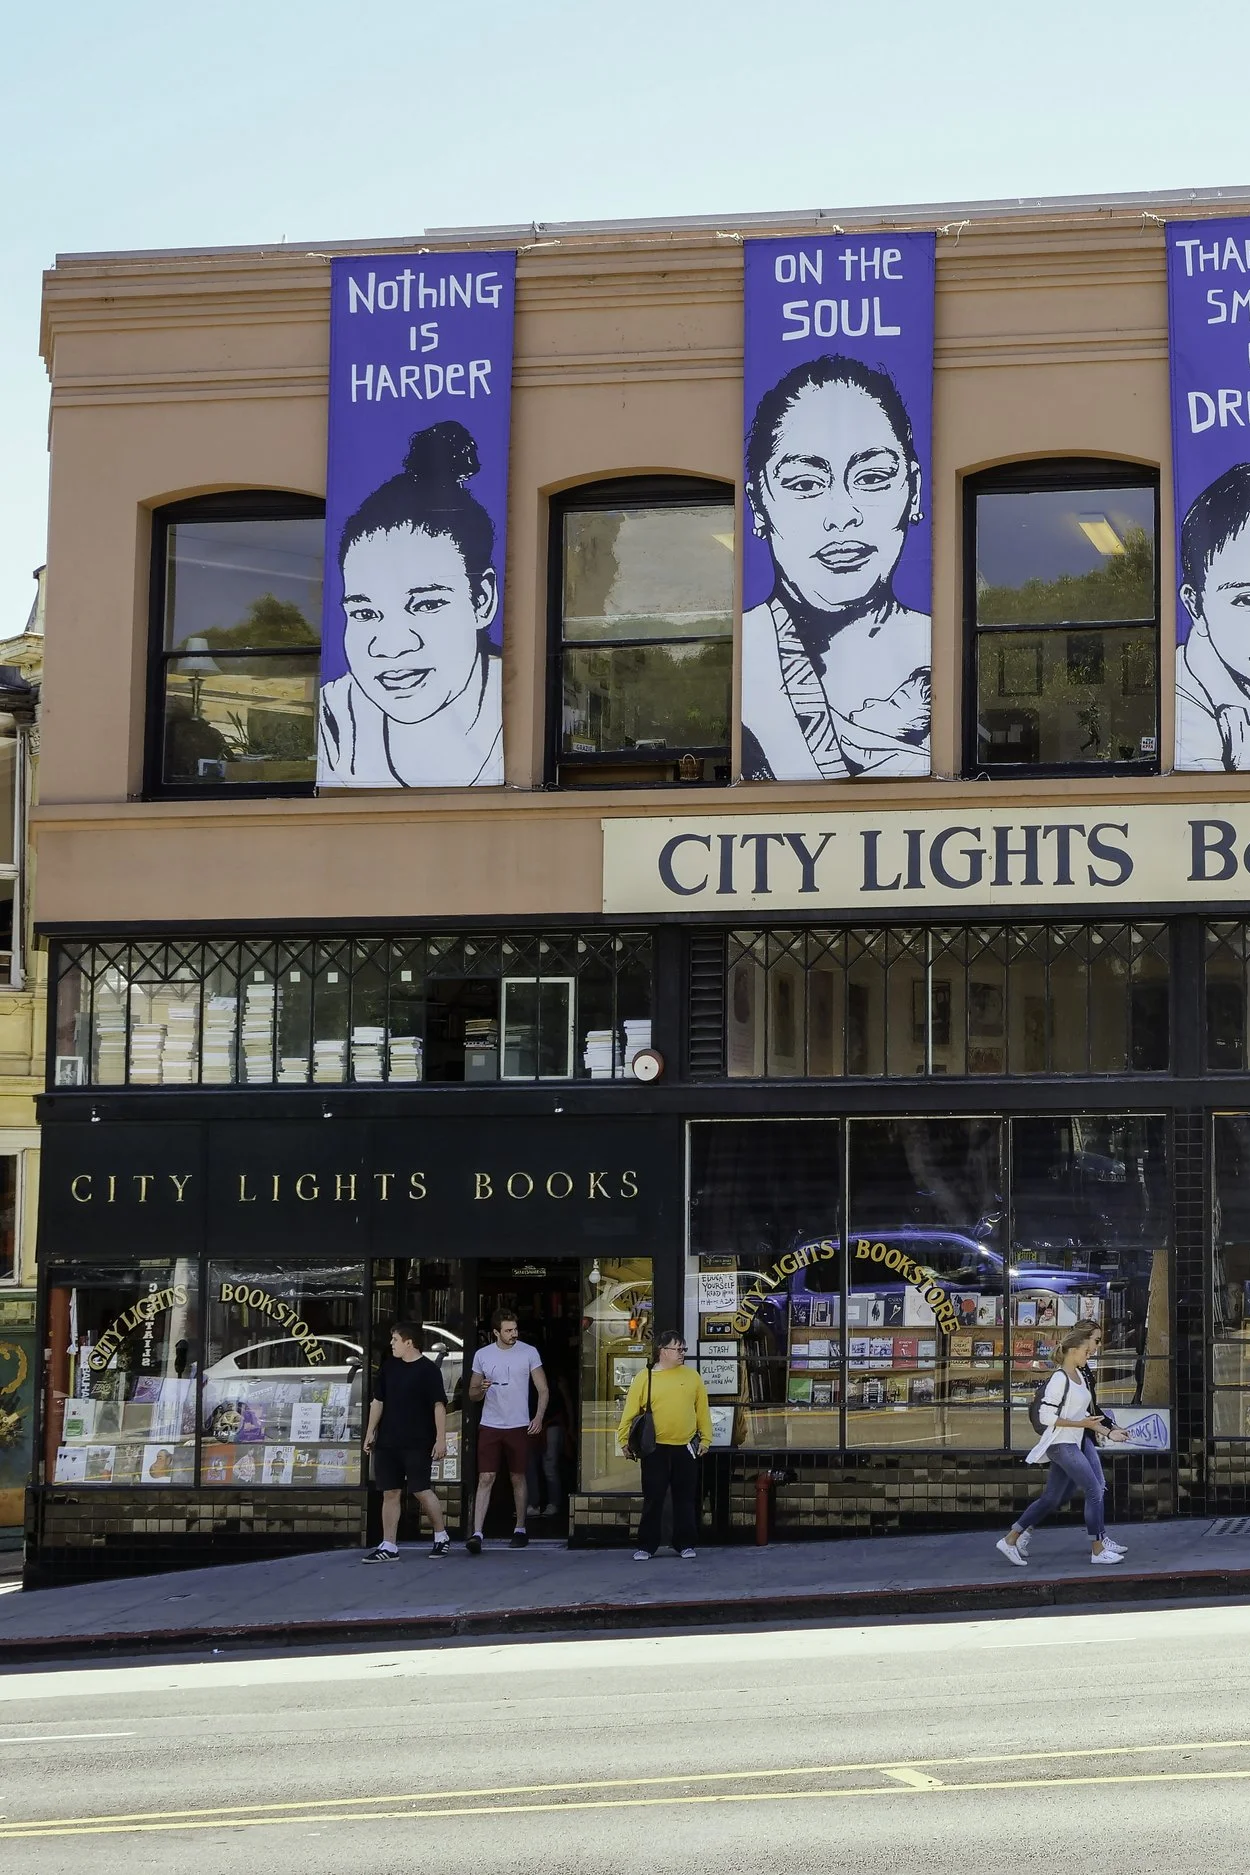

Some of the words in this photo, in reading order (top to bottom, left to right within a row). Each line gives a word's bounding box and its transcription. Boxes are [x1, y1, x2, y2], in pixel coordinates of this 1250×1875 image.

[775, 249, 823, 285] ON
[409, 322, 440, 353] IS
[782, 297, 901, 341] SOUL
[658, 832, 836, 896] CITY
[859, 823, 1134, 892] LIGHTS
[71, 1174, 194, 1202] CITY
[238, 1171, 427, 1202] LIGHTS
[473, 1169, 640, 1199] BOOKS
[701, 1282, 735, 1292] YOURSELF
[733, 1281, 770, 1335] CITY
[763, 1239, 836, 1290] LIGHTS
[855, 1238, 962, 1336] BOOKSTORE
[88, 1319, 125, 1371] CITY
[120, 1284, 188, 1332] LIGHTS
[221, 1283, 326, 1365] BOOKSTORE
[709, 1345, 729, 1355] STASH
